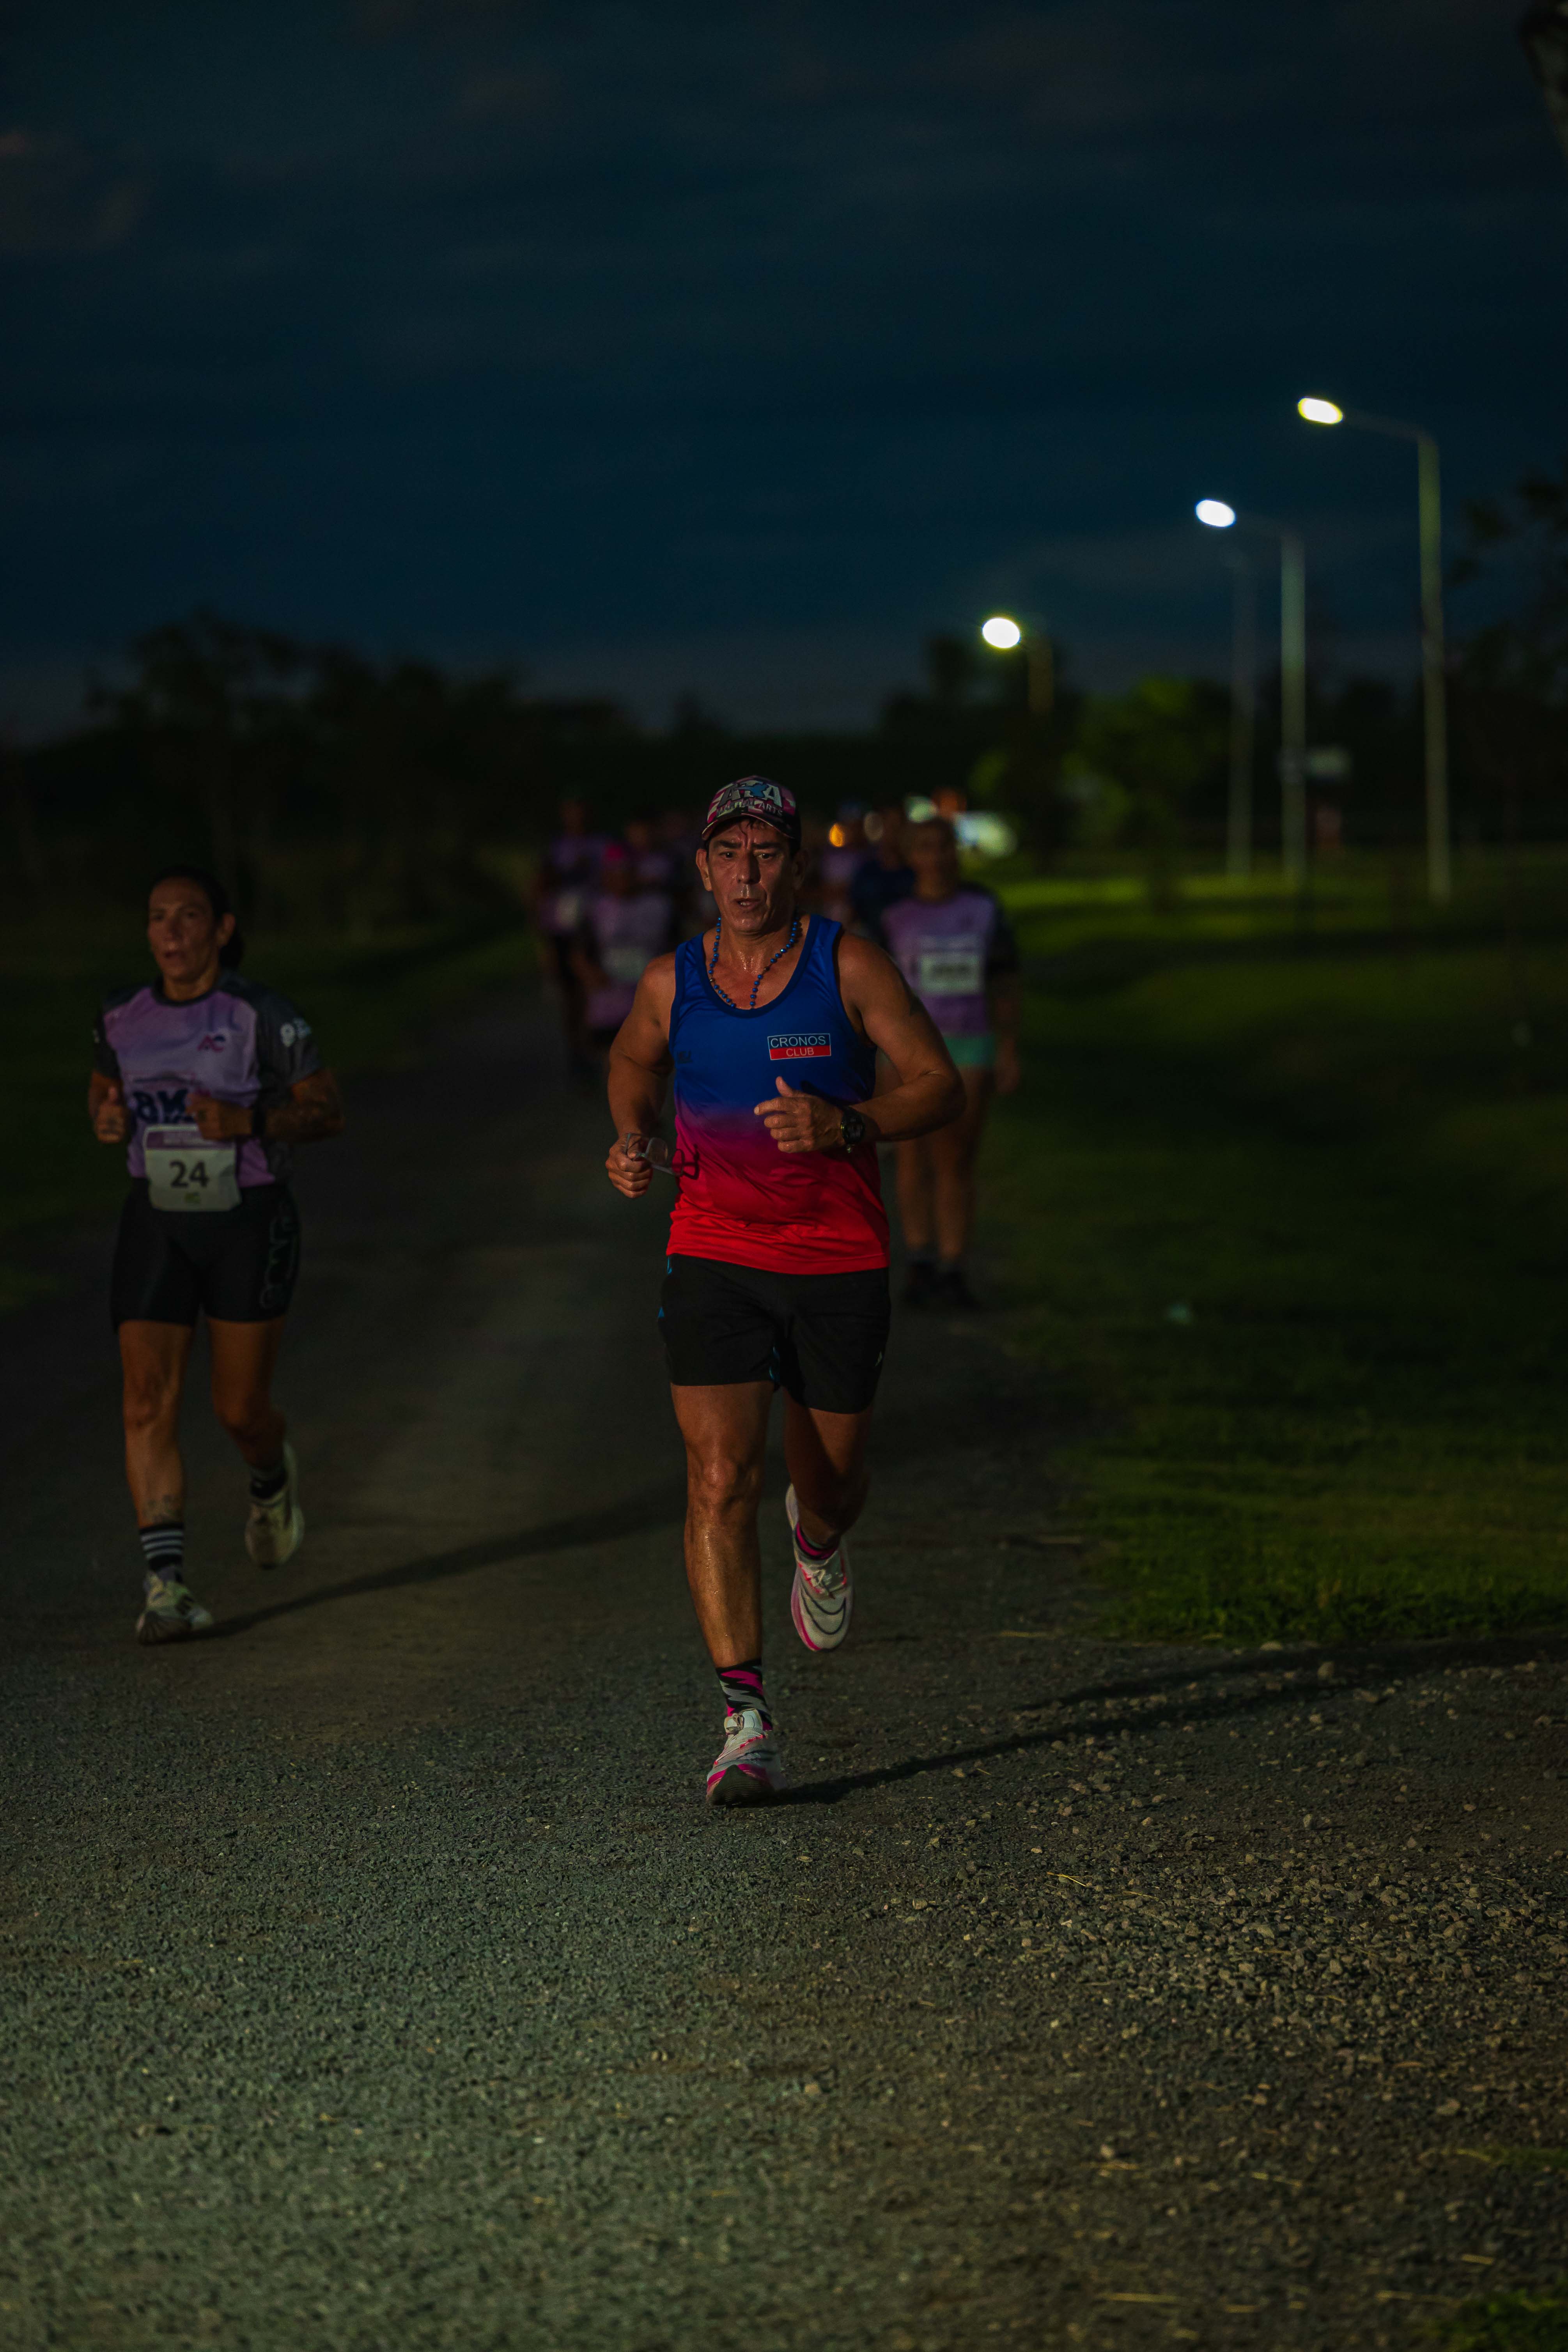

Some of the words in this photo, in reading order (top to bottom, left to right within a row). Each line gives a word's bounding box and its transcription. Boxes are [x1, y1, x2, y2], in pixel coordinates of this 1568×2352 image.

[758, 801, 783, 817] ARTS
[770, 1036, 826, 1048] CRONOS
[786, 1047, 815, 1057] CLUB
[169, 1158, 209, 1188] 24
